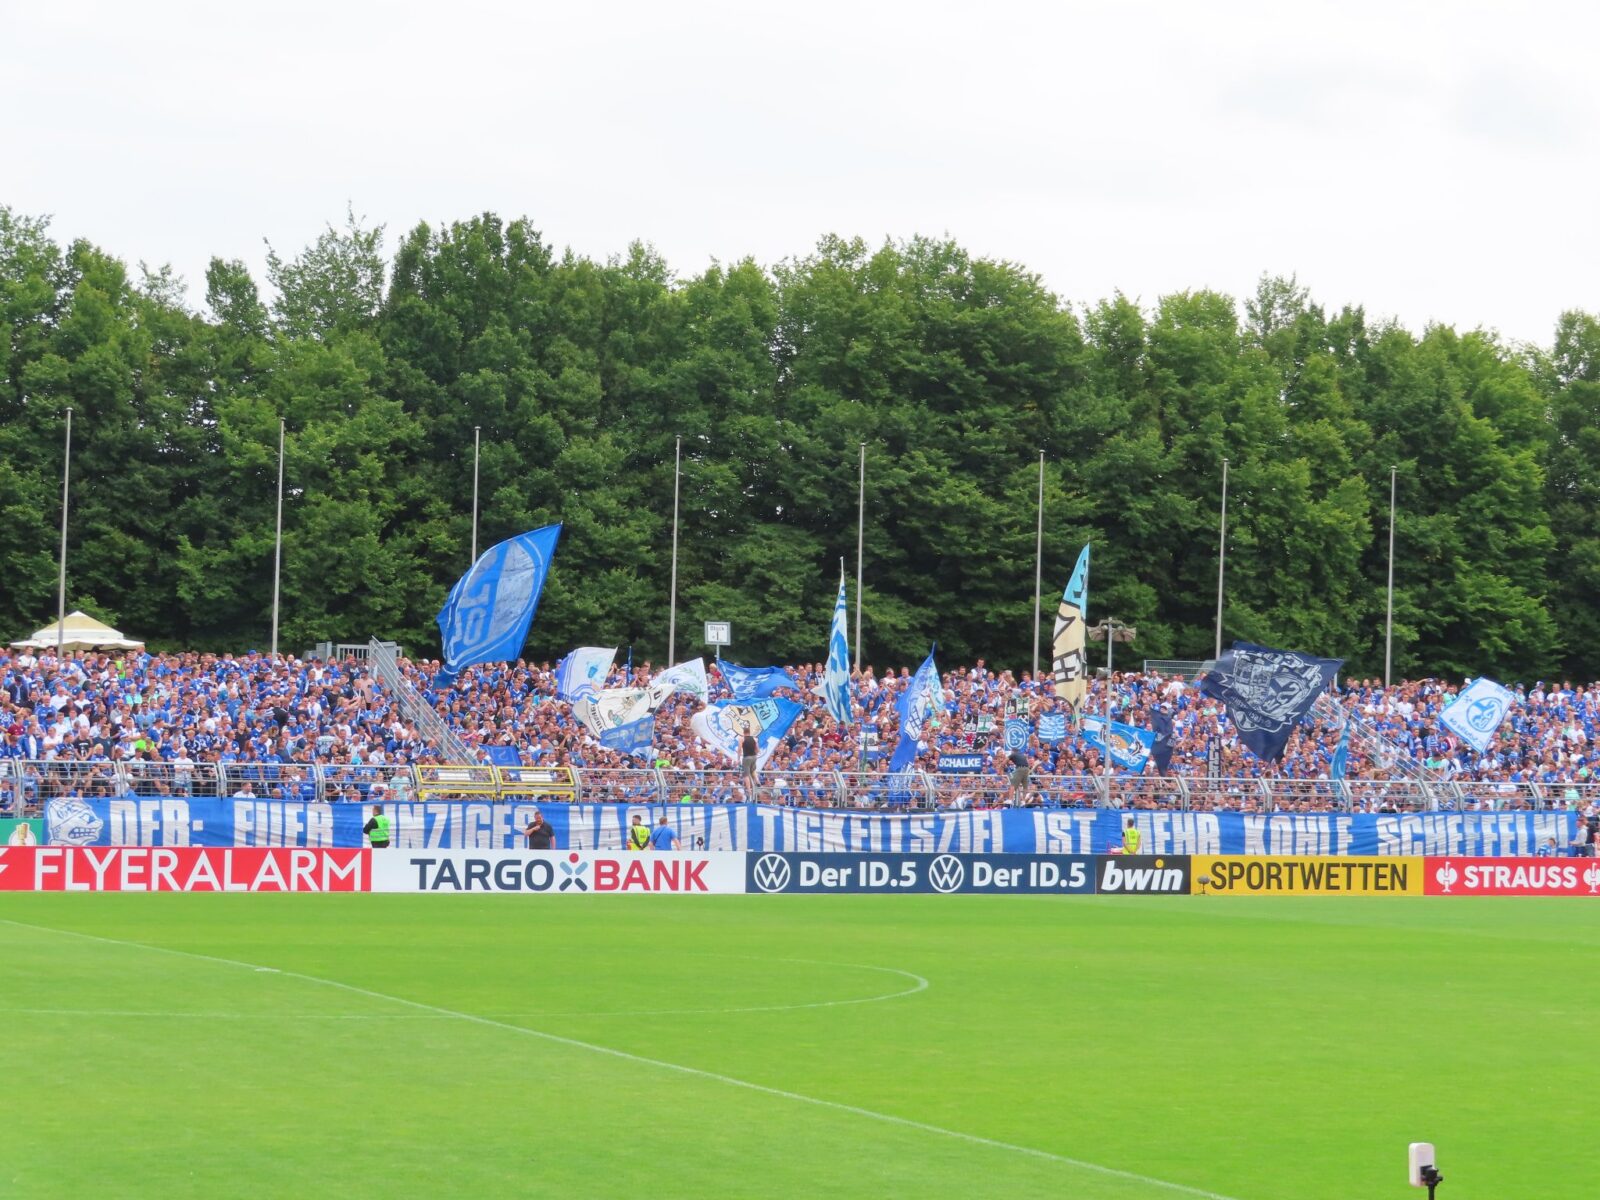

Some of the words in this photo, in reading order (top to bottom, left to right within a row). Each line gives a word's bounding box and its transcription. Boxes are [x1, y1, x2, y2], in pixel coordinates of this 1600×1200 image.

[939, 757, 981, 767] SCHALKE
[110, 800, 204, 847] DFB:
[234, 801, 333, 848] EUER
[1033, 811, 1097, 854] IST
[1244, 815, 1353, 856] KOHLE
[34, 848, 362, 892] FLYERALARM
[800, 862, 852, 887] Der
[859, 862, 917, 887] ID.5
[973, 862, 1022, 887] Der
[1030, 862, 1086, 888] ID.5
[1101, 859, 1183, 891] bwin
[1210, 861, 1407, 891] SPORTWETTEN
[1464, 865, 1577, 889] STRAUSS
